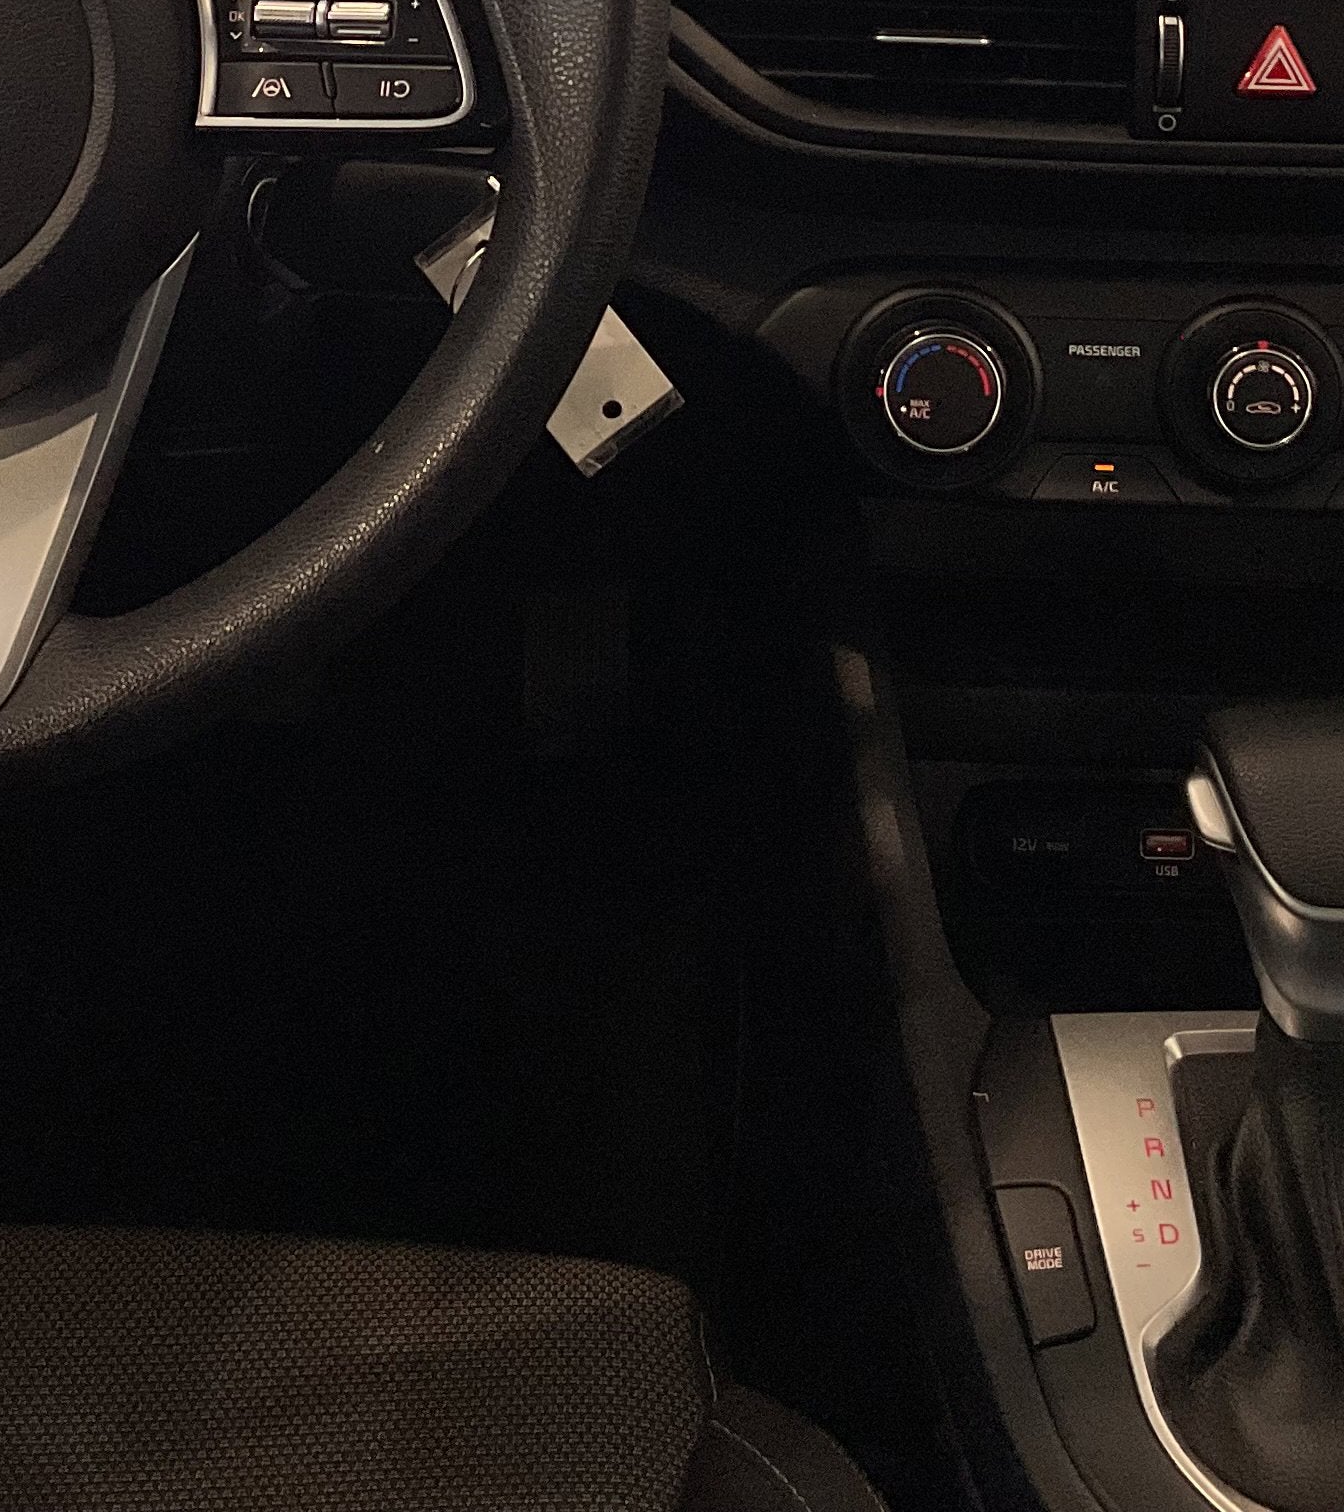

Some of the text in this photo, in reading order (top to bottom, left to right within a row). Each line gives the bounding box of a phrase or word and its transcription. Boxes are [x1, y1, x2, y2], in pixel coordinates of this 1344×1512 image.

[228, 10, 246, 23] OK
[1068, 343, 1142, 358] PASSENGER
[909, 407, 931, 419] A/C
[1092, 480, 1119, 494] A/C
[1155, 865, 1179, 877] USB
[1135, 1097, 1156, 1118] P
[1143, 1137, 1165, 1158] R
[1151, 1179, 1173, 1200] N
[1158, 1223, 1180, 1245] D
[1024, 1246, 1062, 1261] DRIVE
[1027, 1257, 1064, 1271] MODE
